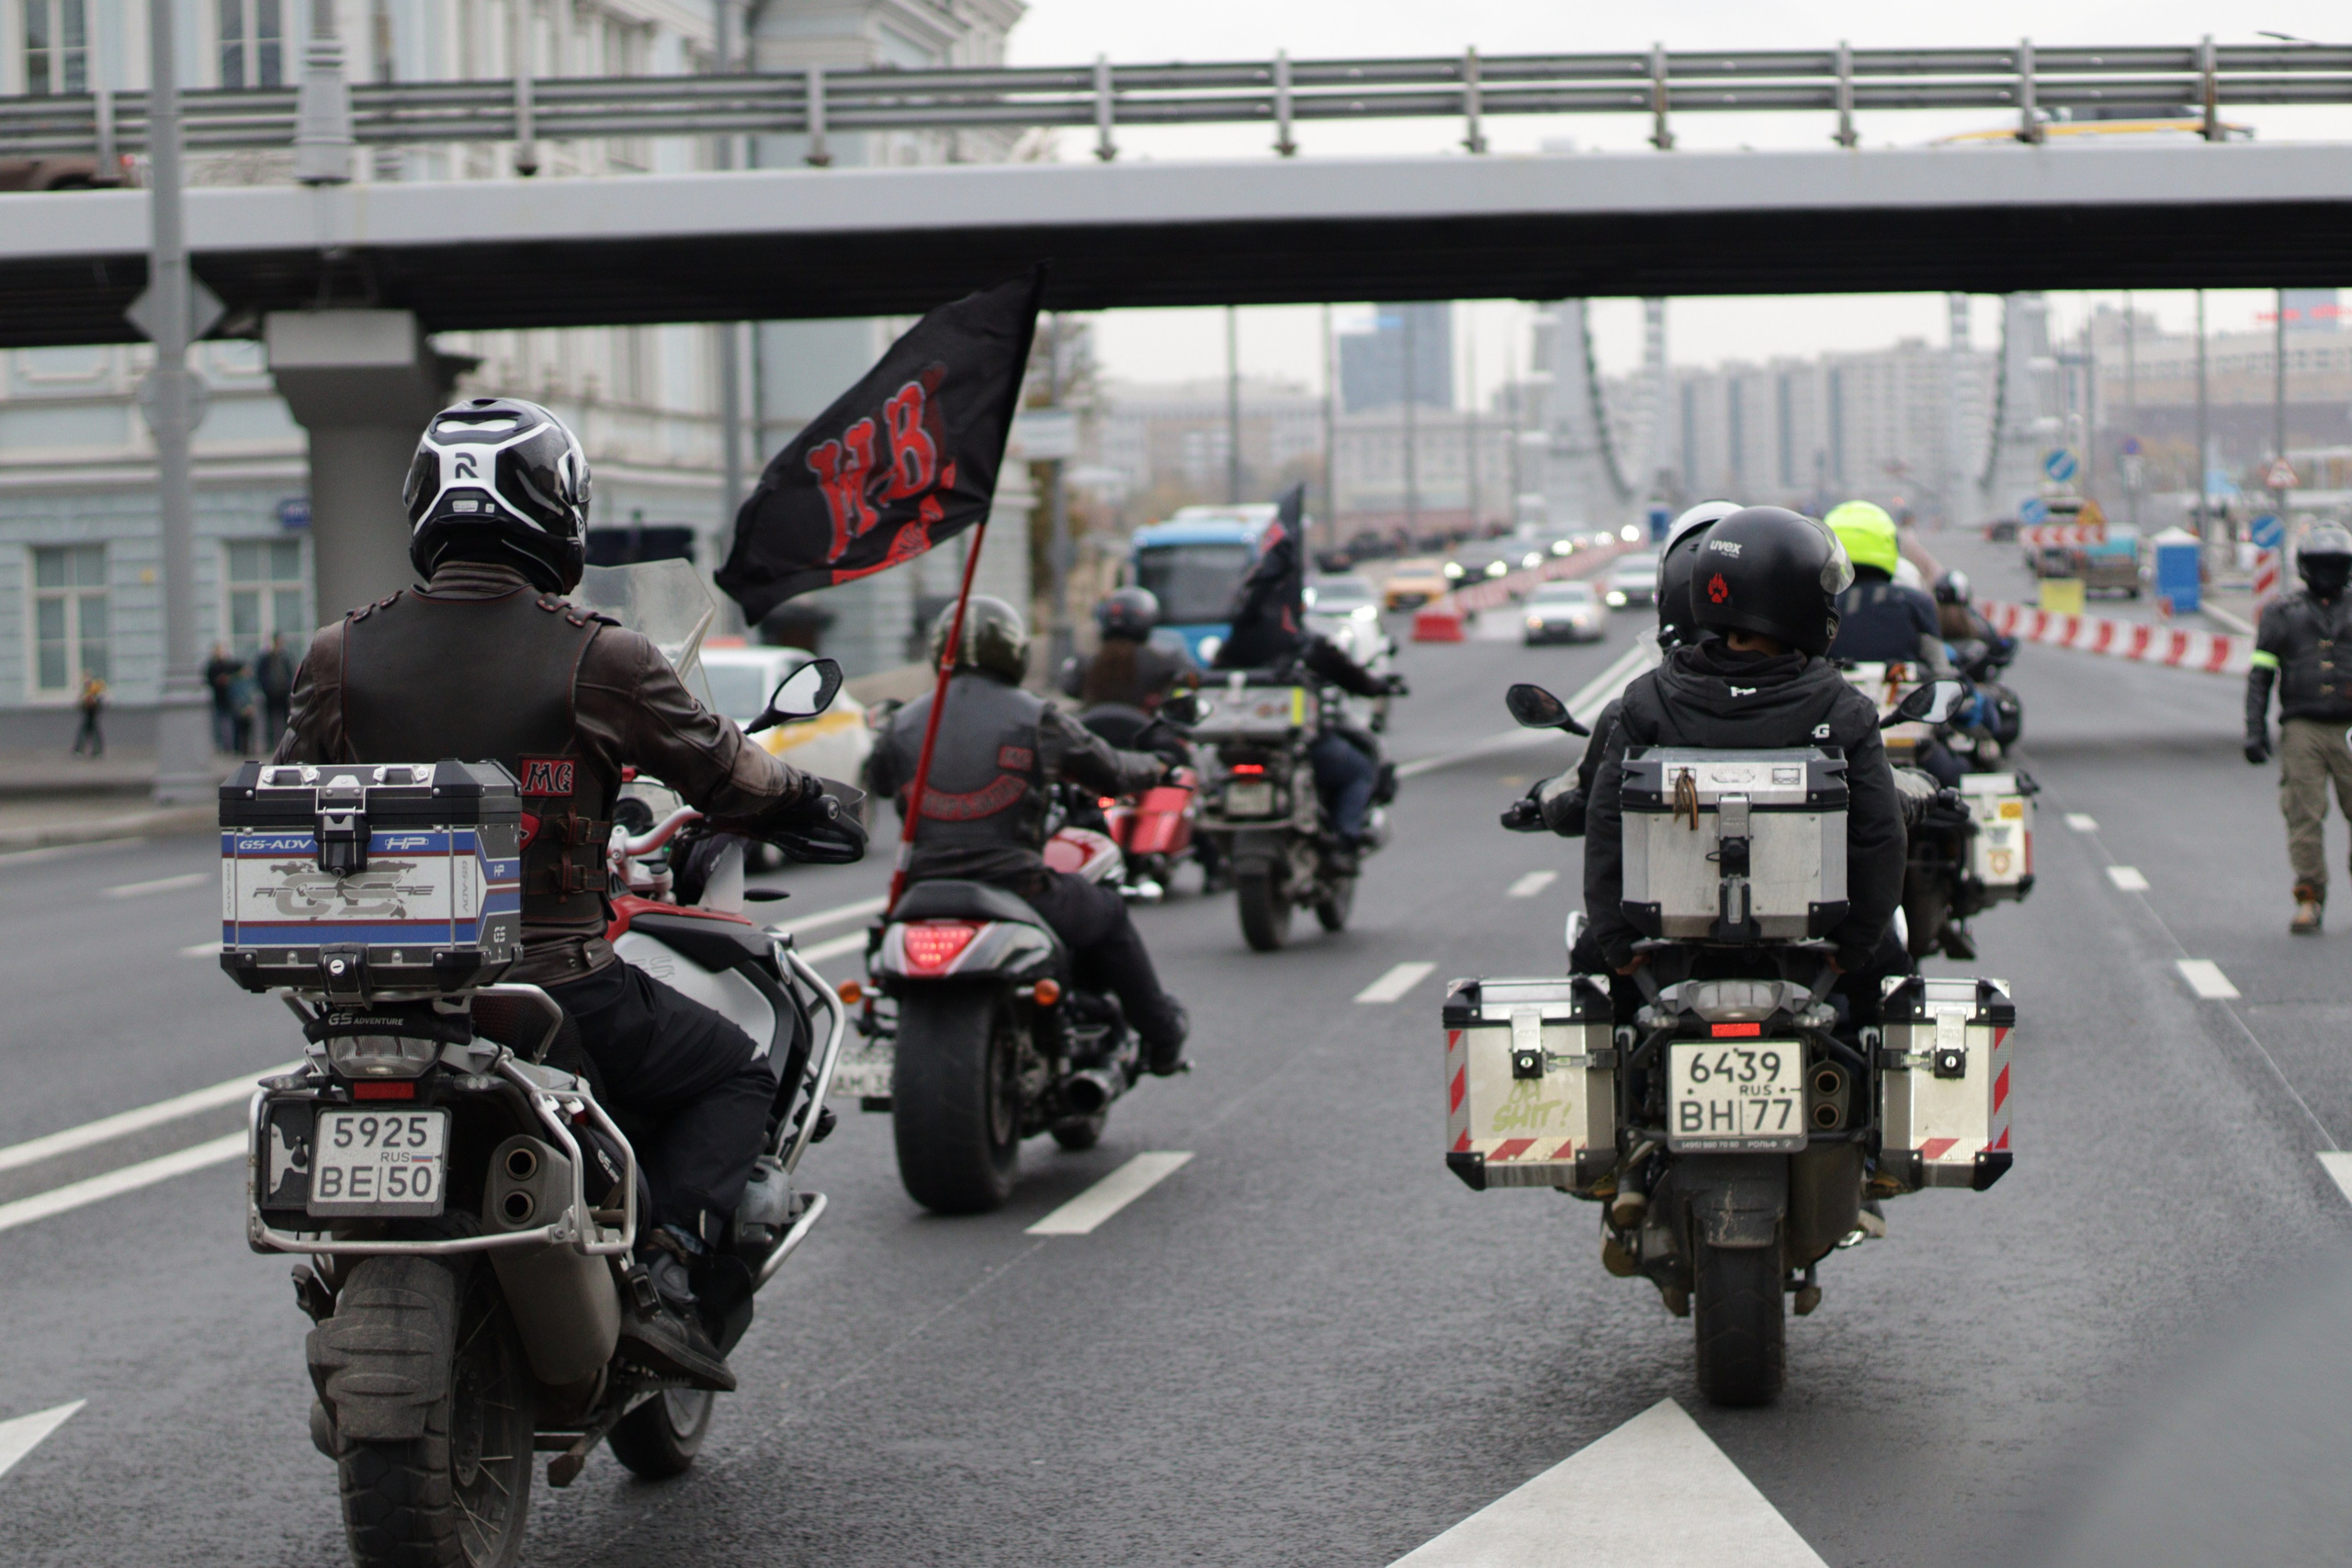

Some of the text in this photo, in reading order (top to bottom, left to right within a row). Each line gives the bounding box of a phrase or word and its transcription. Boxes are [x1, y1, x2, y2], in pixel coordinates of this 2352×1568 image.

[1710, 540, 1742, 554] uvex
[240, 839, 312, 851] GS-ADV
[386, 837, 429, 851] HP
[275, 872, 402, 916] GS
[328, 1012, 404, 1026] GS ADVENTURE
[1690, 1051, 1781, 1084] 6439
[1739, 1085, 1772, 1096] RUS
[1679, 1100, 1793, 1133] BH 77
[333, 1117, 428, 1148] 5925
[380, 1152, 410, 1163] RUS
[319, 1166, 432, 1198] BE 50
